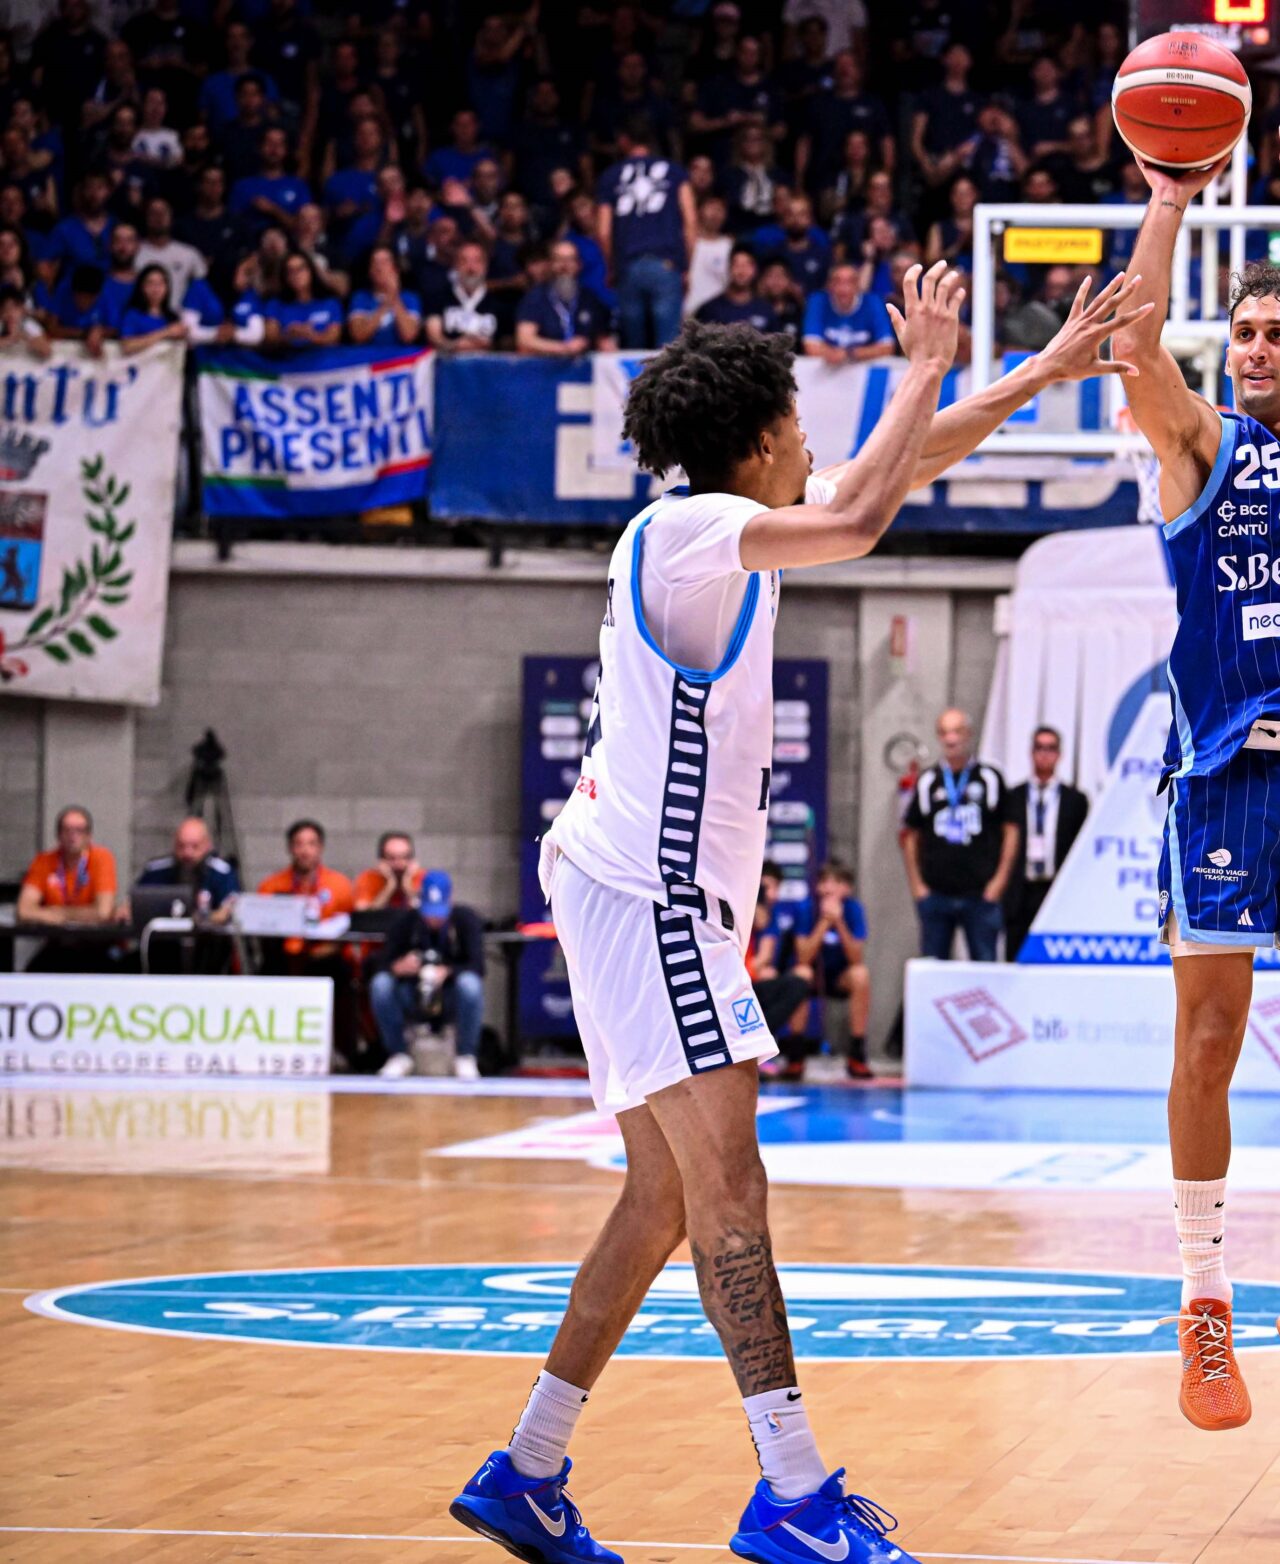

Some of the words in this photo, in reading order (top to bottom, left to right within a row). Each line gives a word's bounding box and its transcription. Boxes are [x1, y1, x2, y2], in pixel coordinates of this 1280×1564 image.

[235, 372, 416, 427] ASSENTI
[220, 408, 433, 474] PRESENTI
[1240, 504, 1268, 516] BCC
[1217, 521, 1268, 538] CANTÙ
[1192, 866, 1224, 875] FRIGERIO
[1225, 869, 1249, 877] VIAGGI
